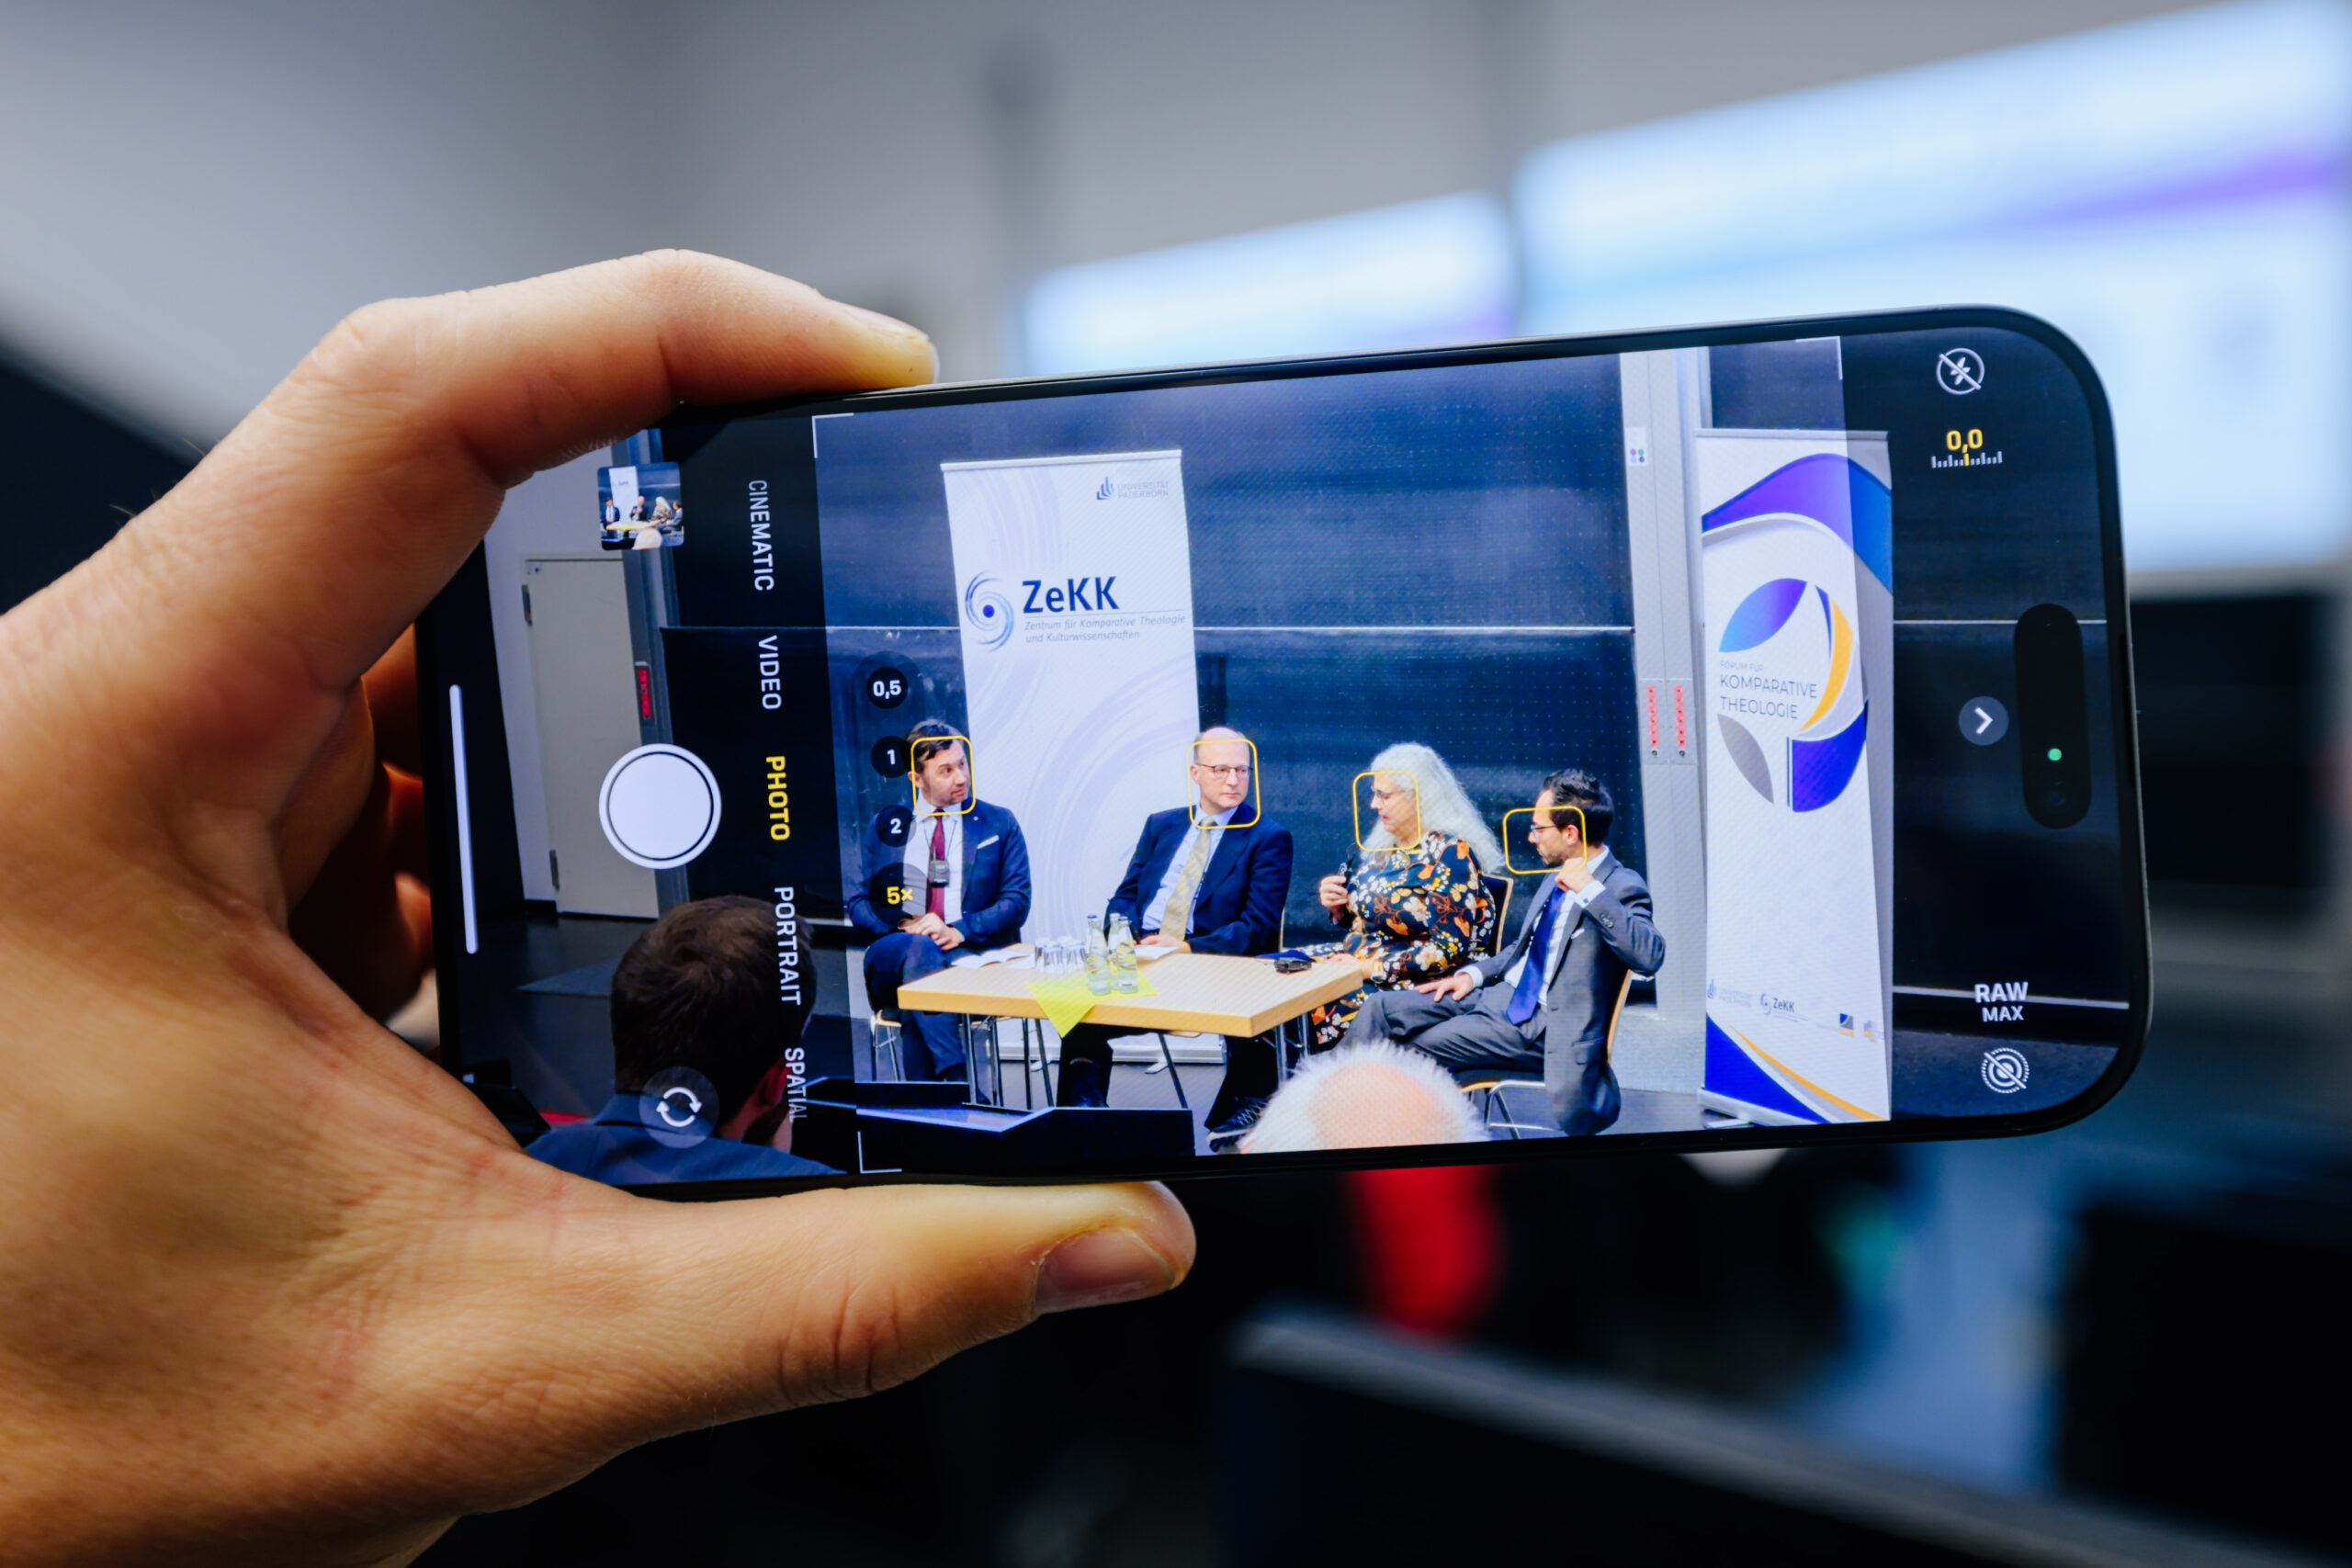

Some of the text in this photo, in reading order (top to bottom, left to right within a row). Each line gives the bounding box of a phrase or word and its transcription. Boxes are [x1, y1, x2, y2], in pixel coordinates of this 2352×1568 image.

[1946, 429, 1983, 453] 0,0
[748, 479, 775, 592] CINEMATIC
[1022, 576, 1120, 613] ZeKK
[1024, 615, 1186, 631] Zentrum für Komparative Theologie
[1025, 630, 1139, 643] und Kulturwissenschaften
[758, 635, 782, 710] VIDEO
[873, 680, 901, 700] 0,5
[1720, 674, 1817, 698] KOMPARATIVE
[1720, 696, 1798, 719] THEOLOGIE
[887, 749, 896, 765] 1
[765, 755, 790, 841] PHOTO
[890, 818, 902, 834] 2
[775, 886, 801, 1006] PORTRAIT
[1974, 982, 2029, 1004] RAW
[1772, 998, 1795, 1013] ZeKK
[1982, 1006, 2024, 1022] MAX
[785, 1047, 808, 1124] SPATIAL
